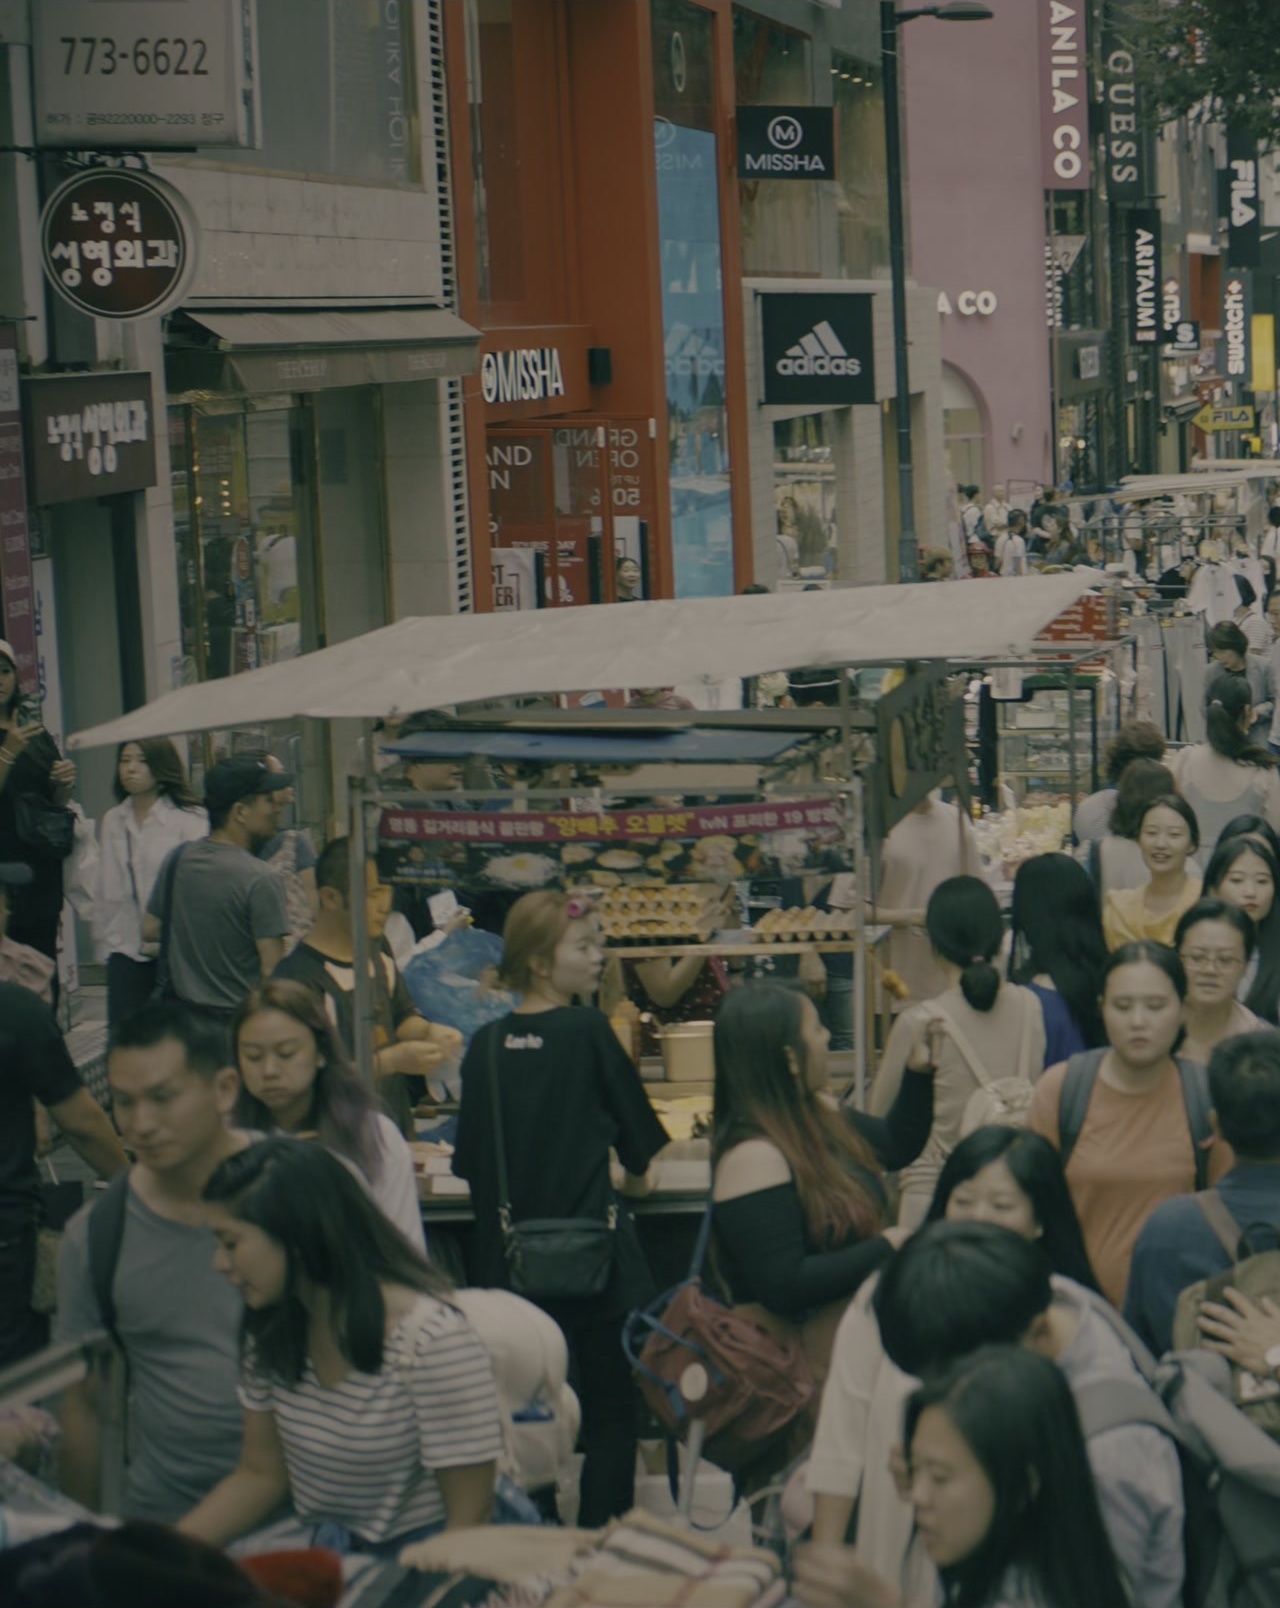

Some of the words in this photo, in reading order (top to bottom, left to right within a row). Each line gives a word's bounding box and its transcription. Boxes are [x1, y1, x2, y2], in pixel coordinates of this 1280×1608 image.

[60, 37, 209, 75] 773-6622
[1108, 50, 1137, 183] GUESS
[745, 153, 825, 171] MISSHA
[1053, 125, 1081, 179] CO
[1230, 160, 1256, 227] FILA
[71, 201, 143, 234] 노정식
[51, 240, 178, 287] 성형외과
[1135, 228, 1156, 327] ARITAUM
[958, 291, 997, 315] CO
[1223, 293, 1246, 375] swatch
[498, 348, 564, 402] MISSHA
[776, 355, 861, 376] adidas
[1213, 410, 1249, 422] FILA
[700, 815, 728, 830] tvN
[783, 809, 802, 824] 19
